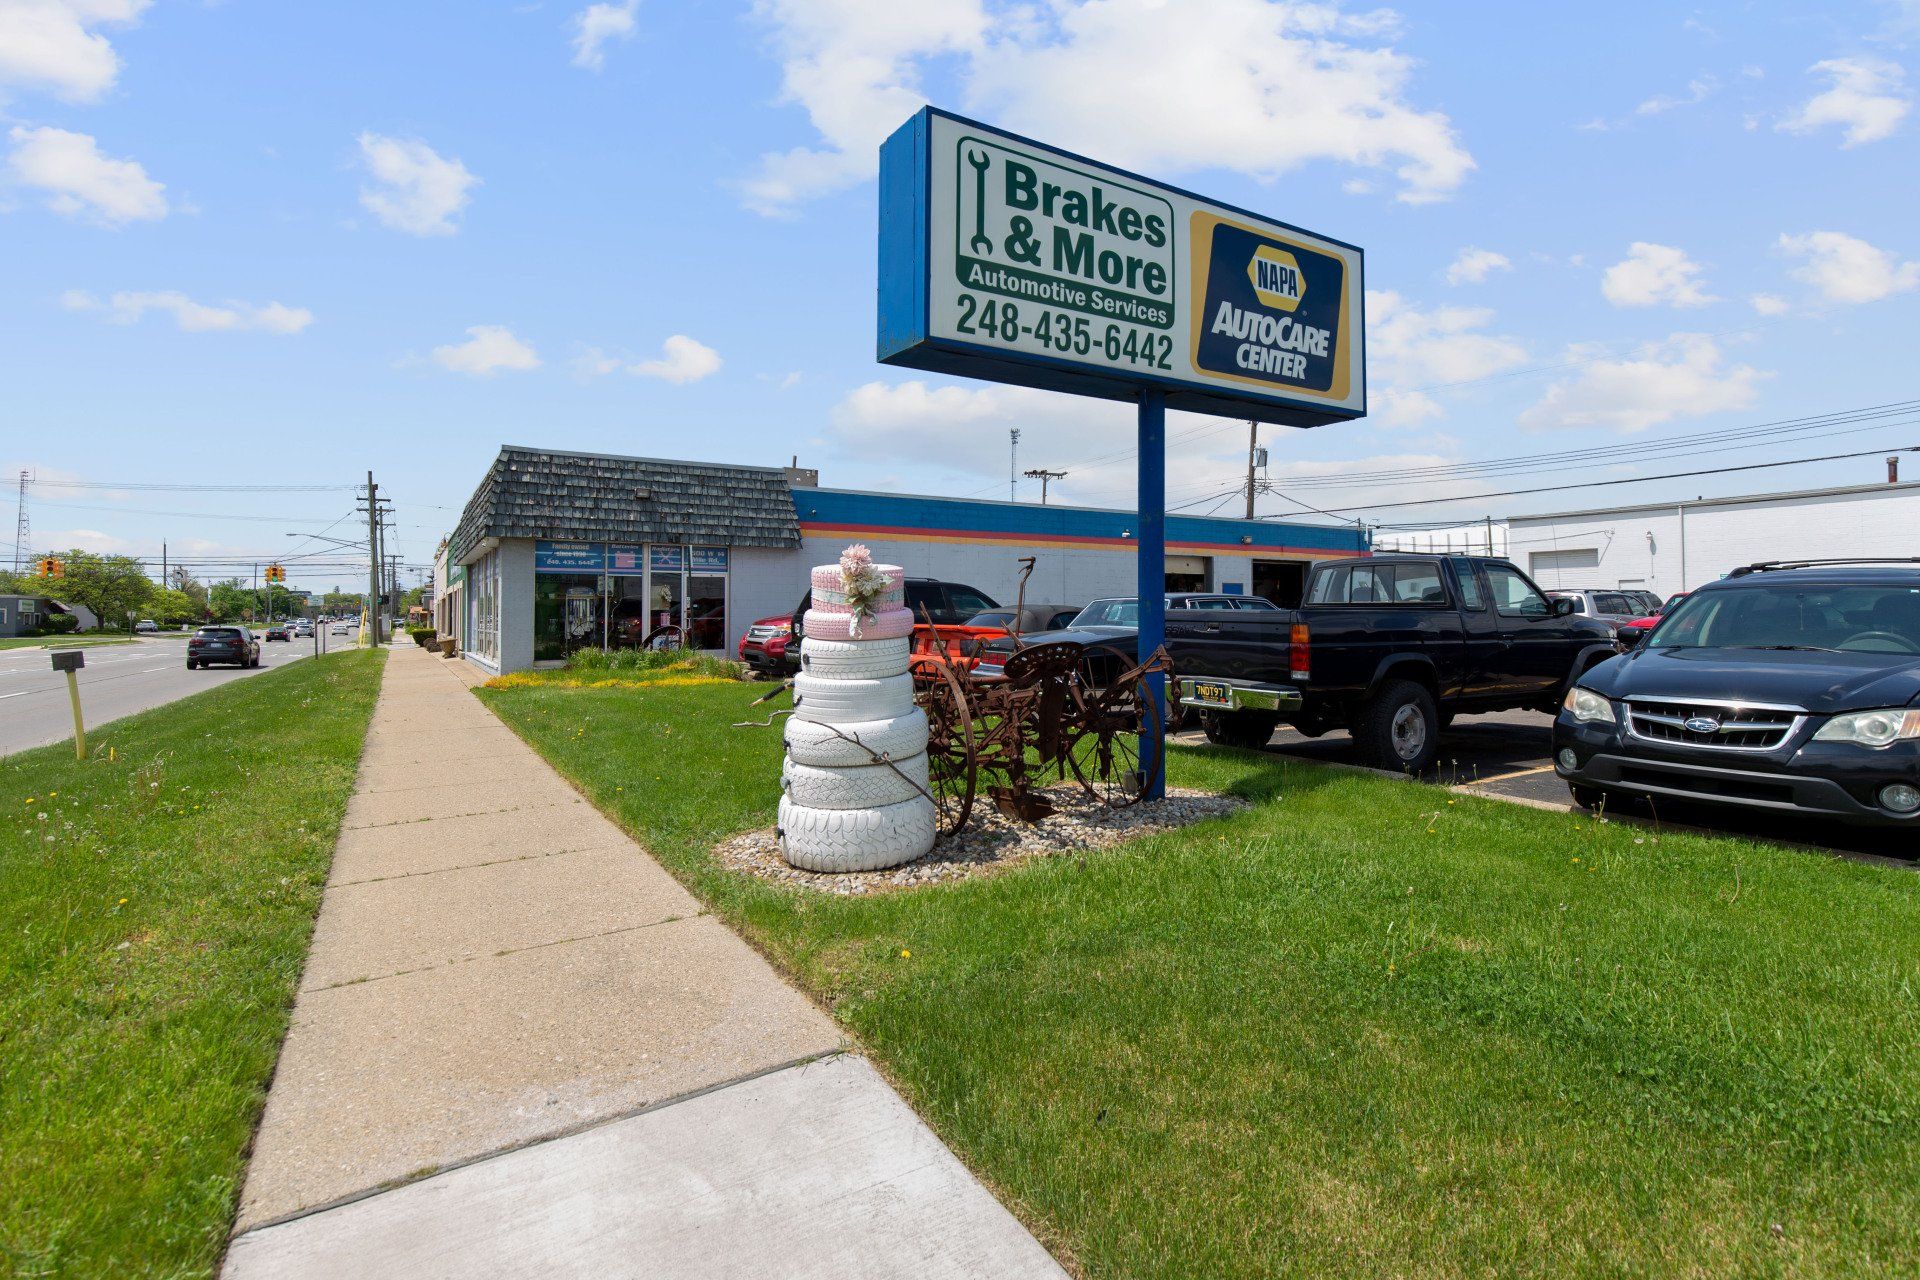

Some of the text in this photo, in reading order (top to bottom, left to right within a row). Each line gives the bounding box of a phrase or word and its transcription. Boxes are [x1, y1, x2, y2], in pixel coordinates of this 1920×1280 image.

[1005, 159, 1167, 248] Brakes
[1004, 215, 1168, 296] & More
[1257, 259, 1299, 298] NAPA
[968, 263, 1167, 325] Automotive Services
[956, 293, 1173, 371] 248-435-6442
[1236, 343, 1308, 380] CENTER
